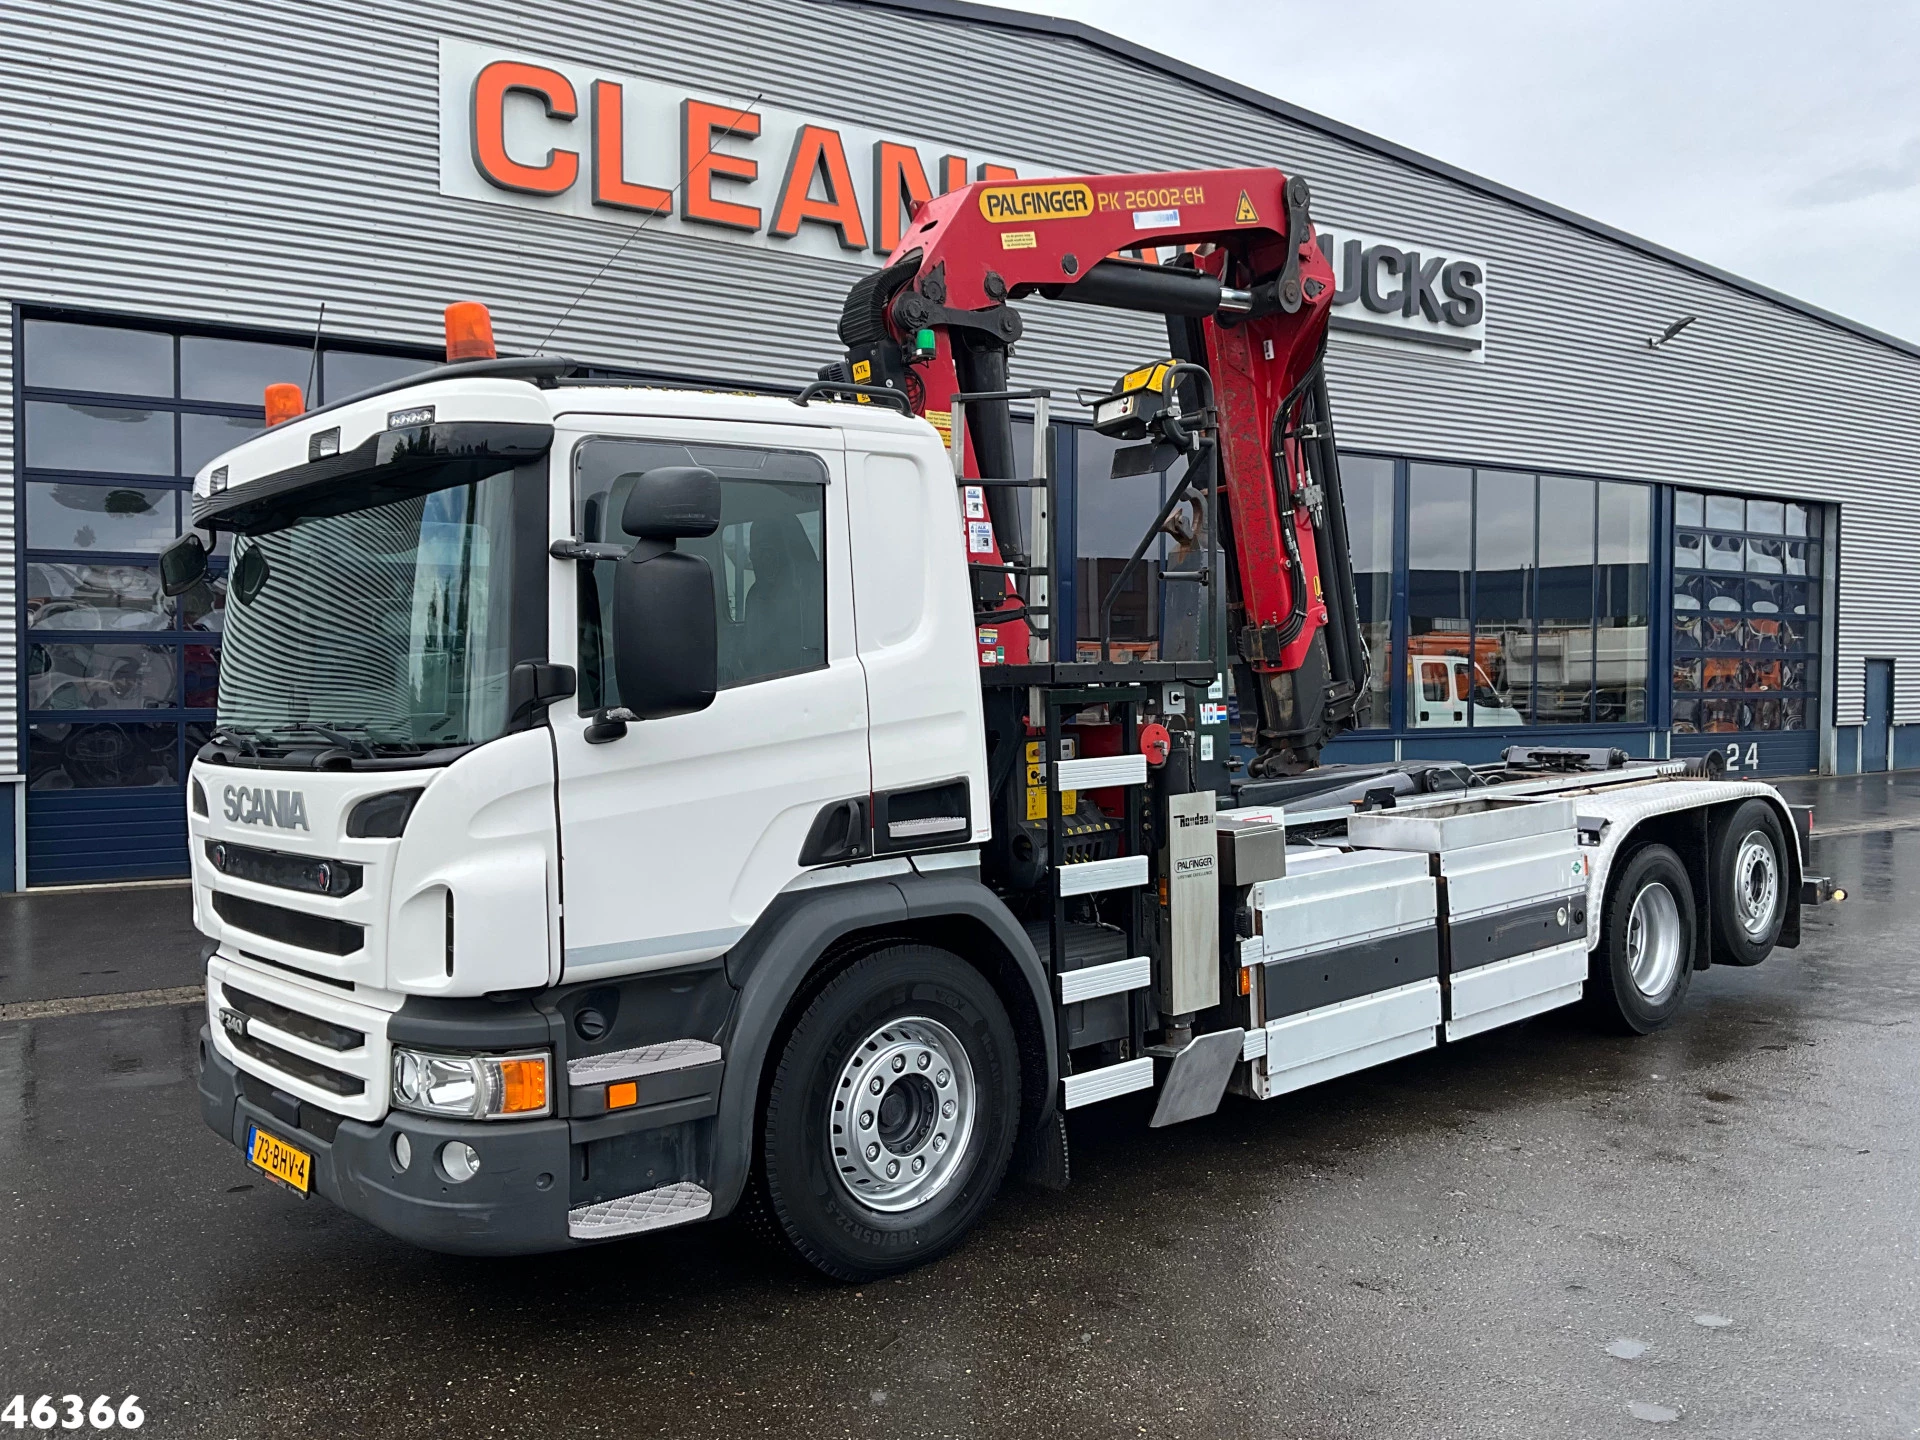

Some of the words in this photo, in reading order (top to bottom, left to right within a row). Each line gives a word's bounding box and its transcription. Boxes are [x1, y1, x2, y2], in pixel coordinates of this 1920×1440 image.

[470, 60, 1200, 266] CLEAN
[986, 190, 1088, 217] PALFINGER
[1098, 193, 1120, 211] PK
[1316, 233, 1483, 327] UCKS
[1726, 742, 1759, 771] 24
[223, 784, 310, 832] SCANIA
[1177, 857, 1212, 870] PALFINGER
[257, 1135, 305, 1185] 73-BHV-4
